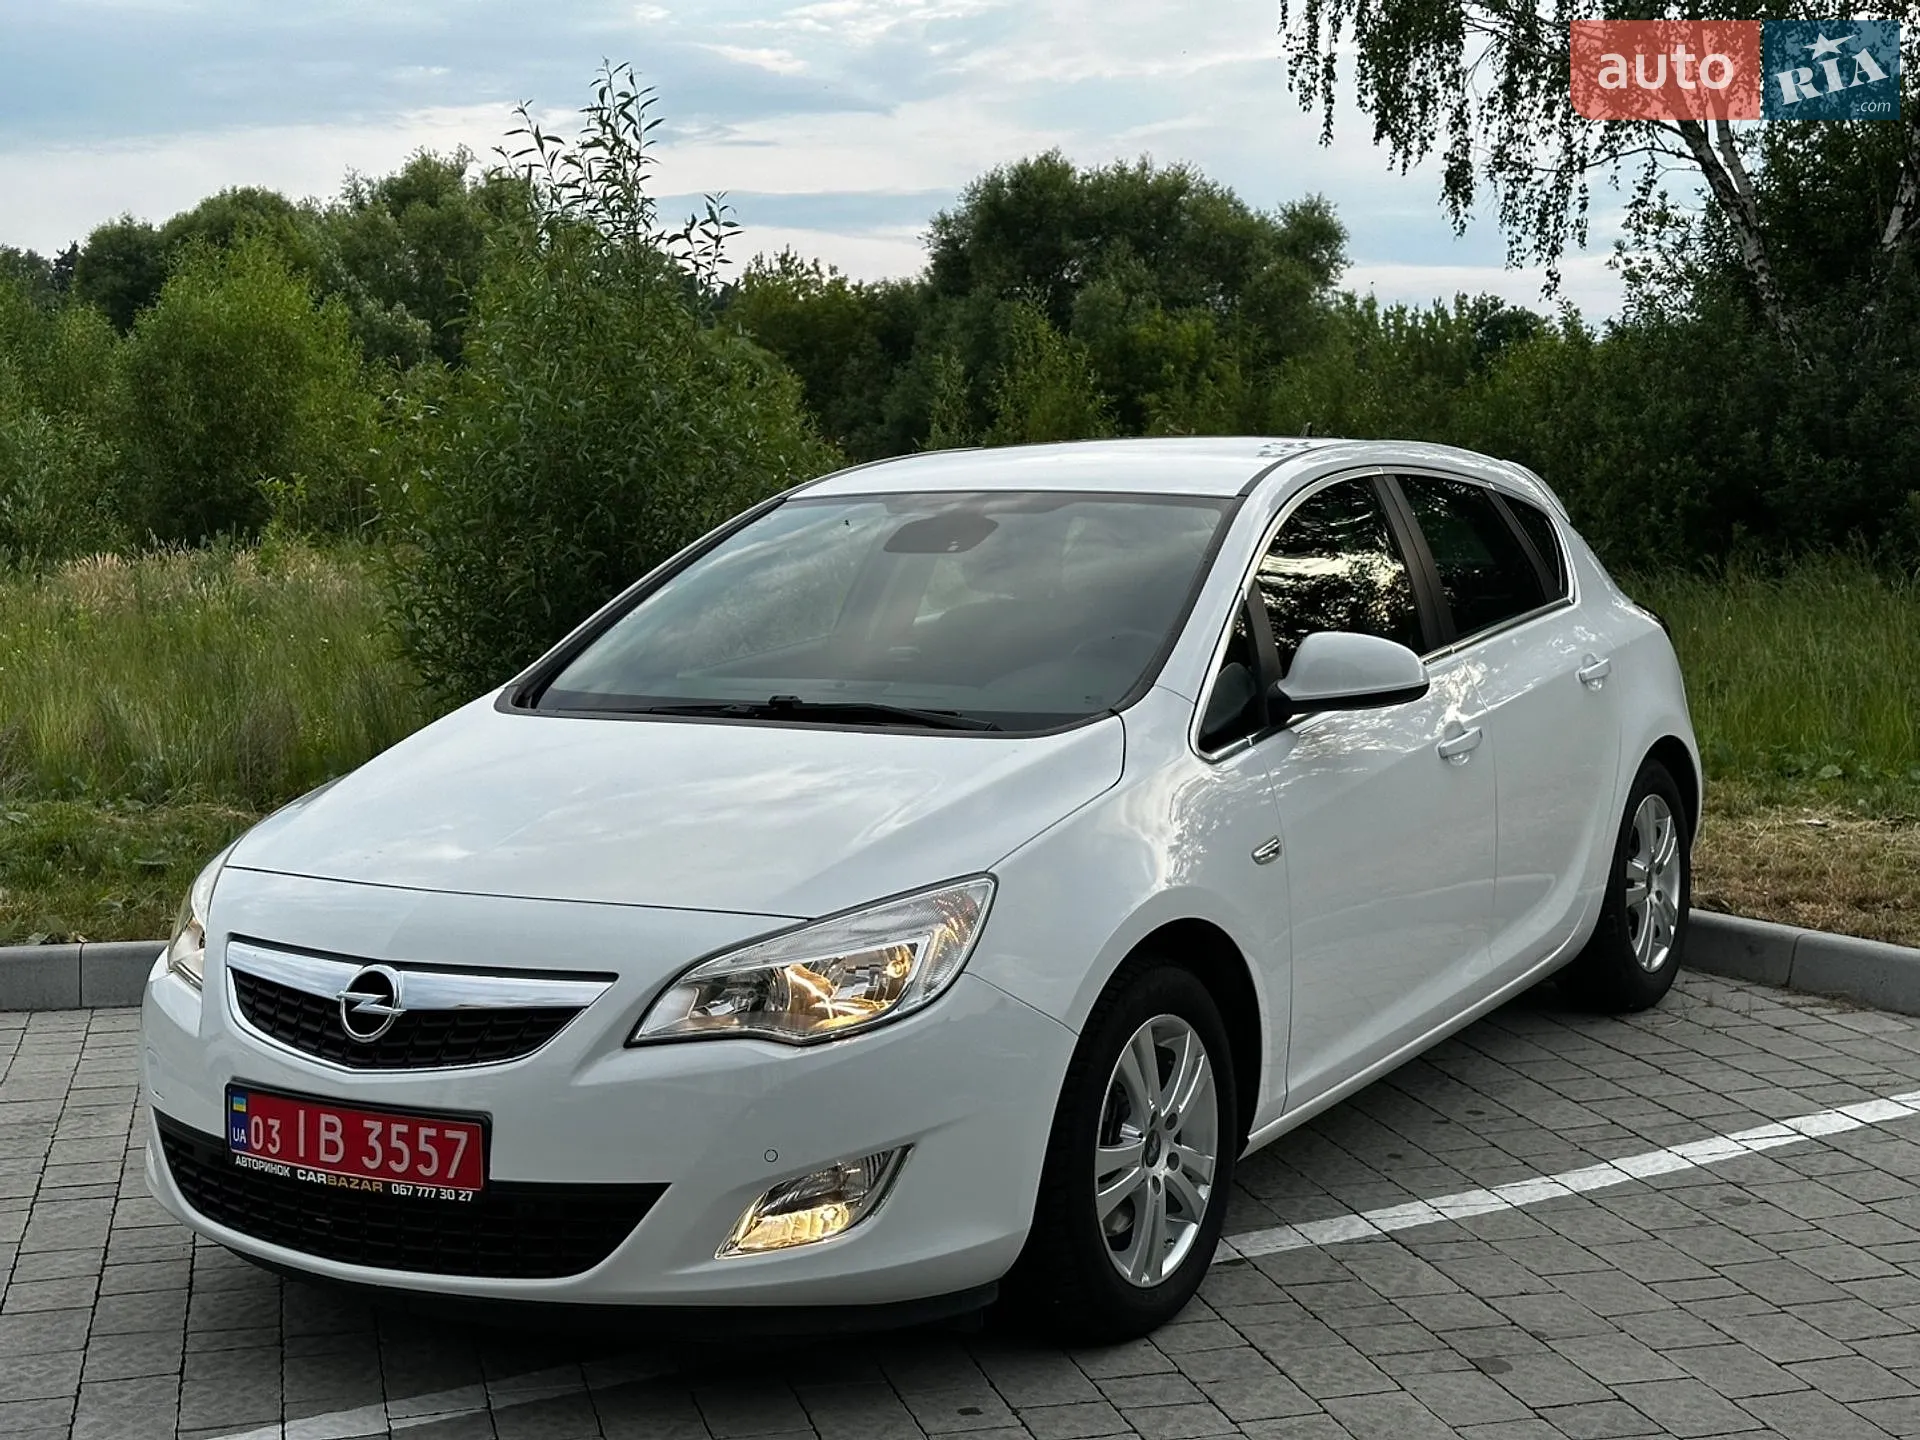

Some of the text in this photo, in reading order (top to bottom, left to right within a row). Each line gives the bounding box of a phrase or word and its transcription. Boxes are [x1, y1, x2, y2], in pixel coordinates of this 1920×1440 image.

[233, 1127, 247, 1144] UA
[250, 1115, 281, 1155] 03
[361, 1119, 468, 1179] 3557
[235, 1154, 473, 1202] АВТОРИНОК CARBAZAR 067 777 30 27
